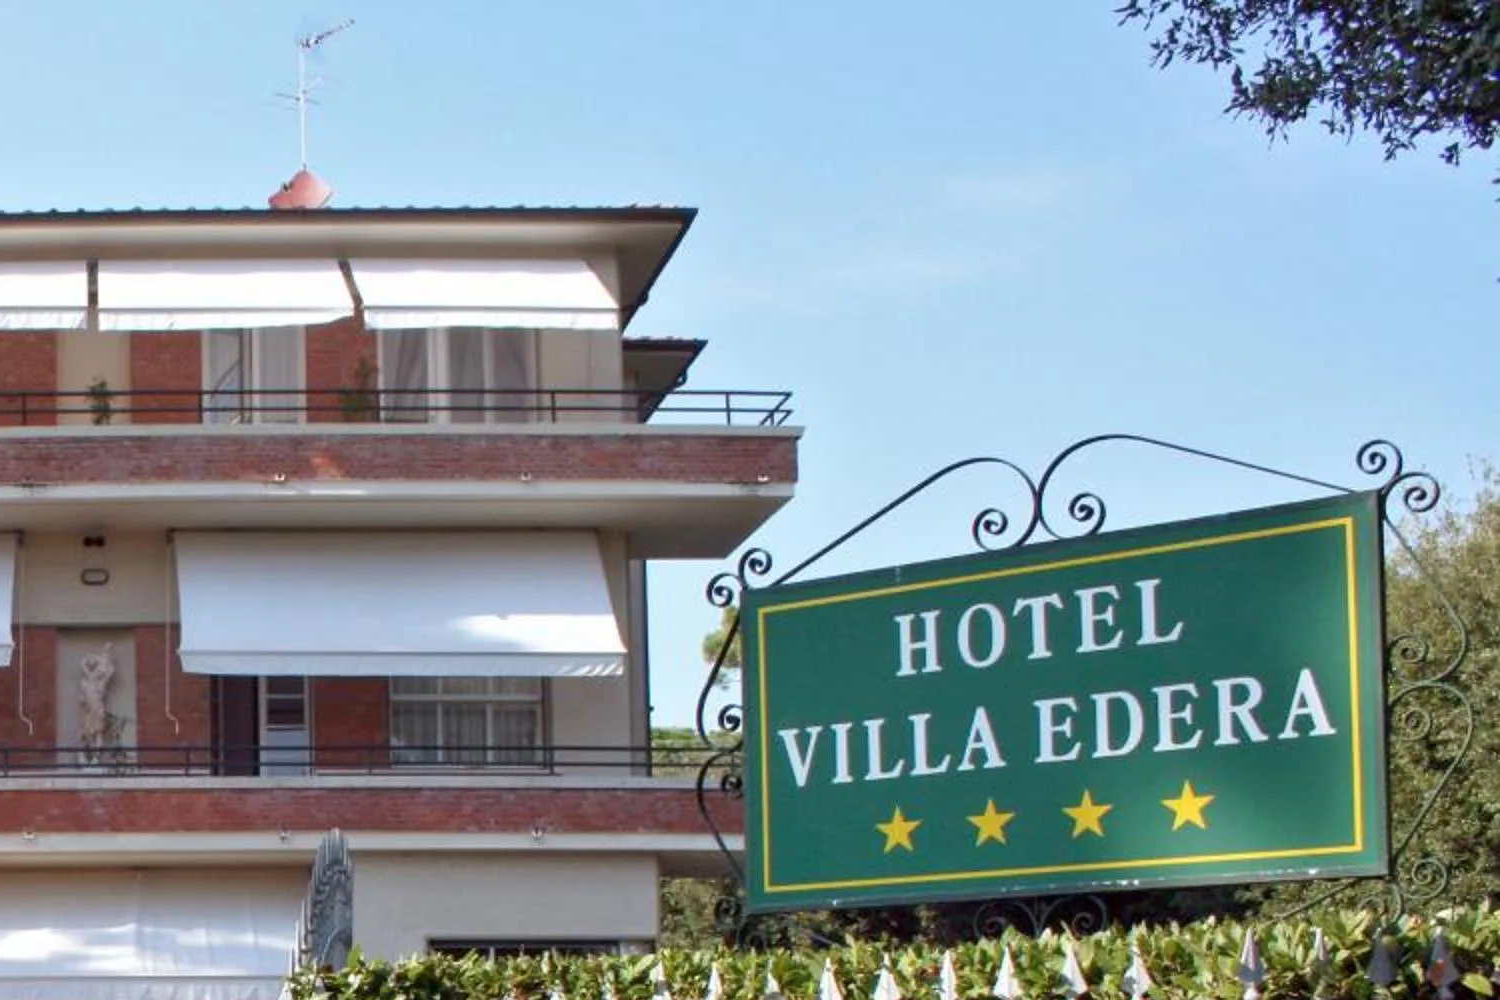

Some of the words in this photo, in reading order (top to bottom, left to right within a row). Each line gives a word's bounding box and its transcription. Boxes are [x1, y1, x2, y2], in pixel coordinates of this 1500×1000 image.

[894, 579, 1183, 676] HOTEL
[778, 706, 1006, 787] VILLA
[1033, 668, 1336, 764] EDERA
